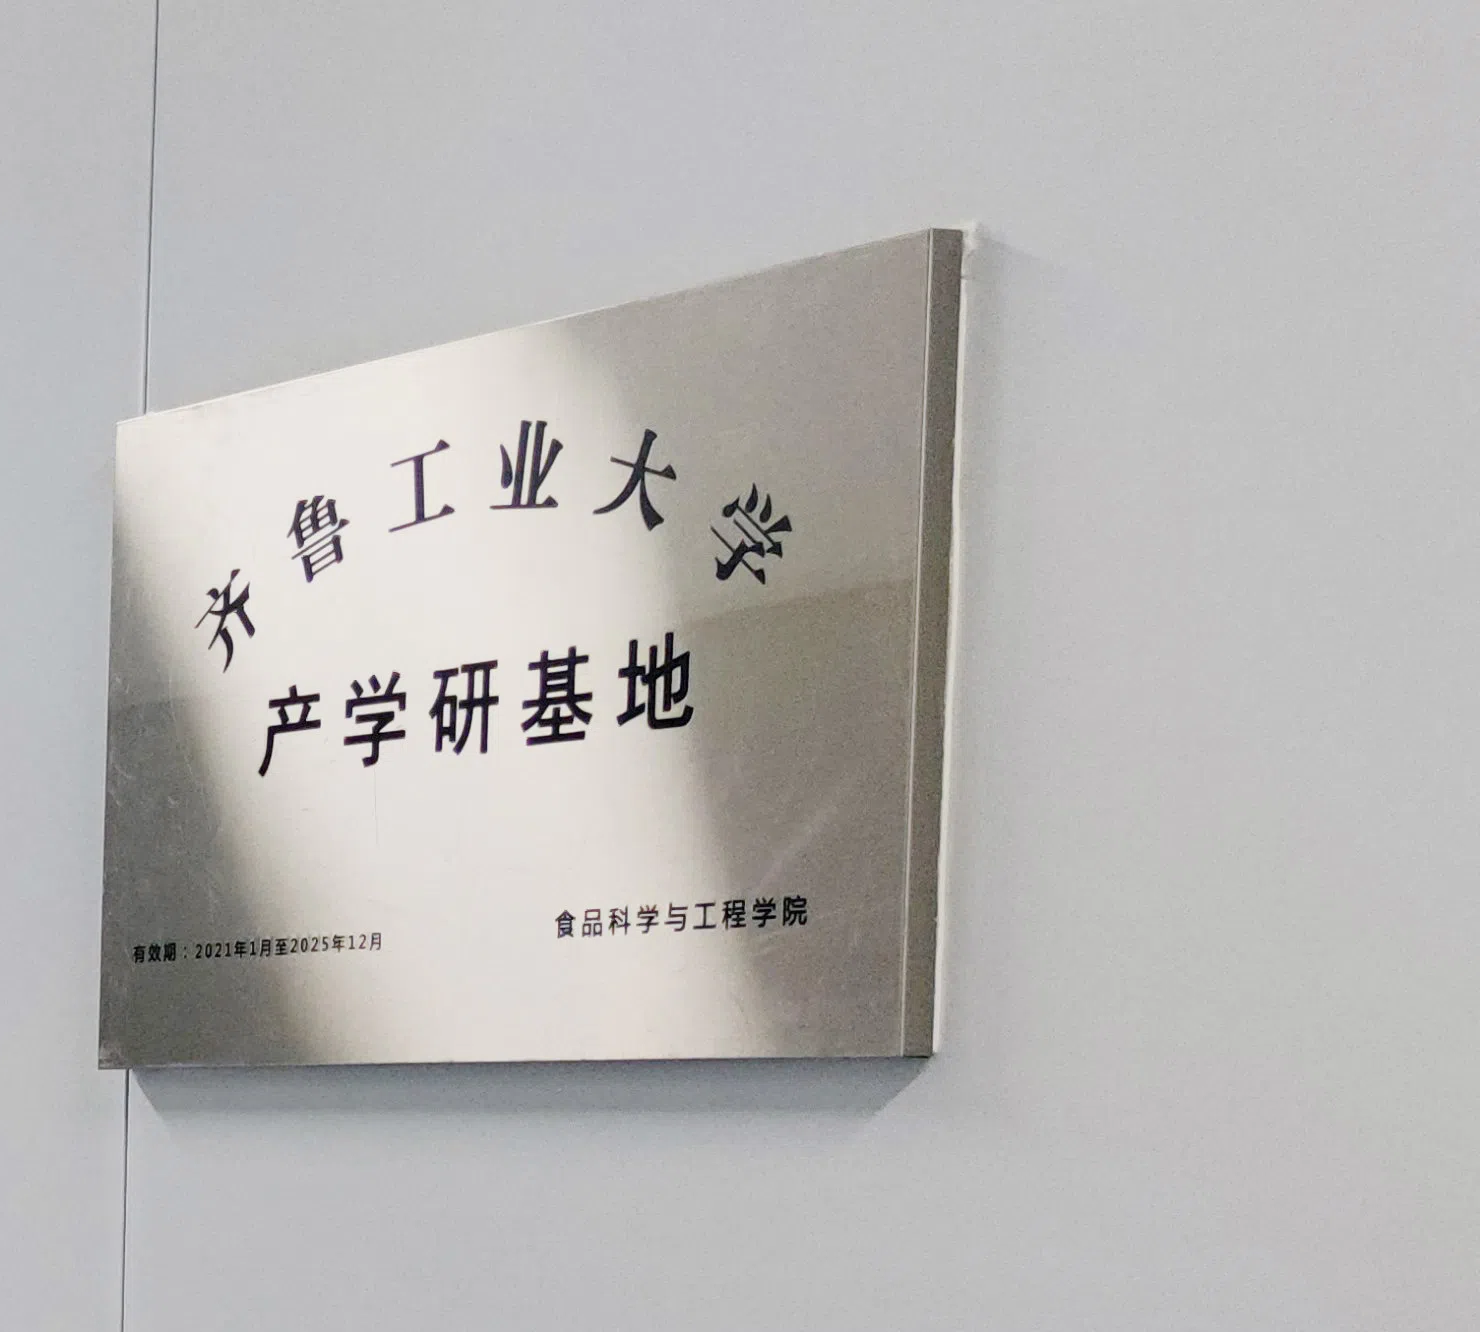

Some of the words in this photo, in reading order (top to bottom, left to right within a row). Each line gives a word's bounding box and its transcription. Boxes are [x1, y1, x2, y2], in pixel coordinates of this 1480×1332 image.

[194, 420, 794, 673] 齐鲁工业大学
[257, 632, 694, 778] 产学研基地
[555, 895, 808, 938] 食品科学与工程学院
